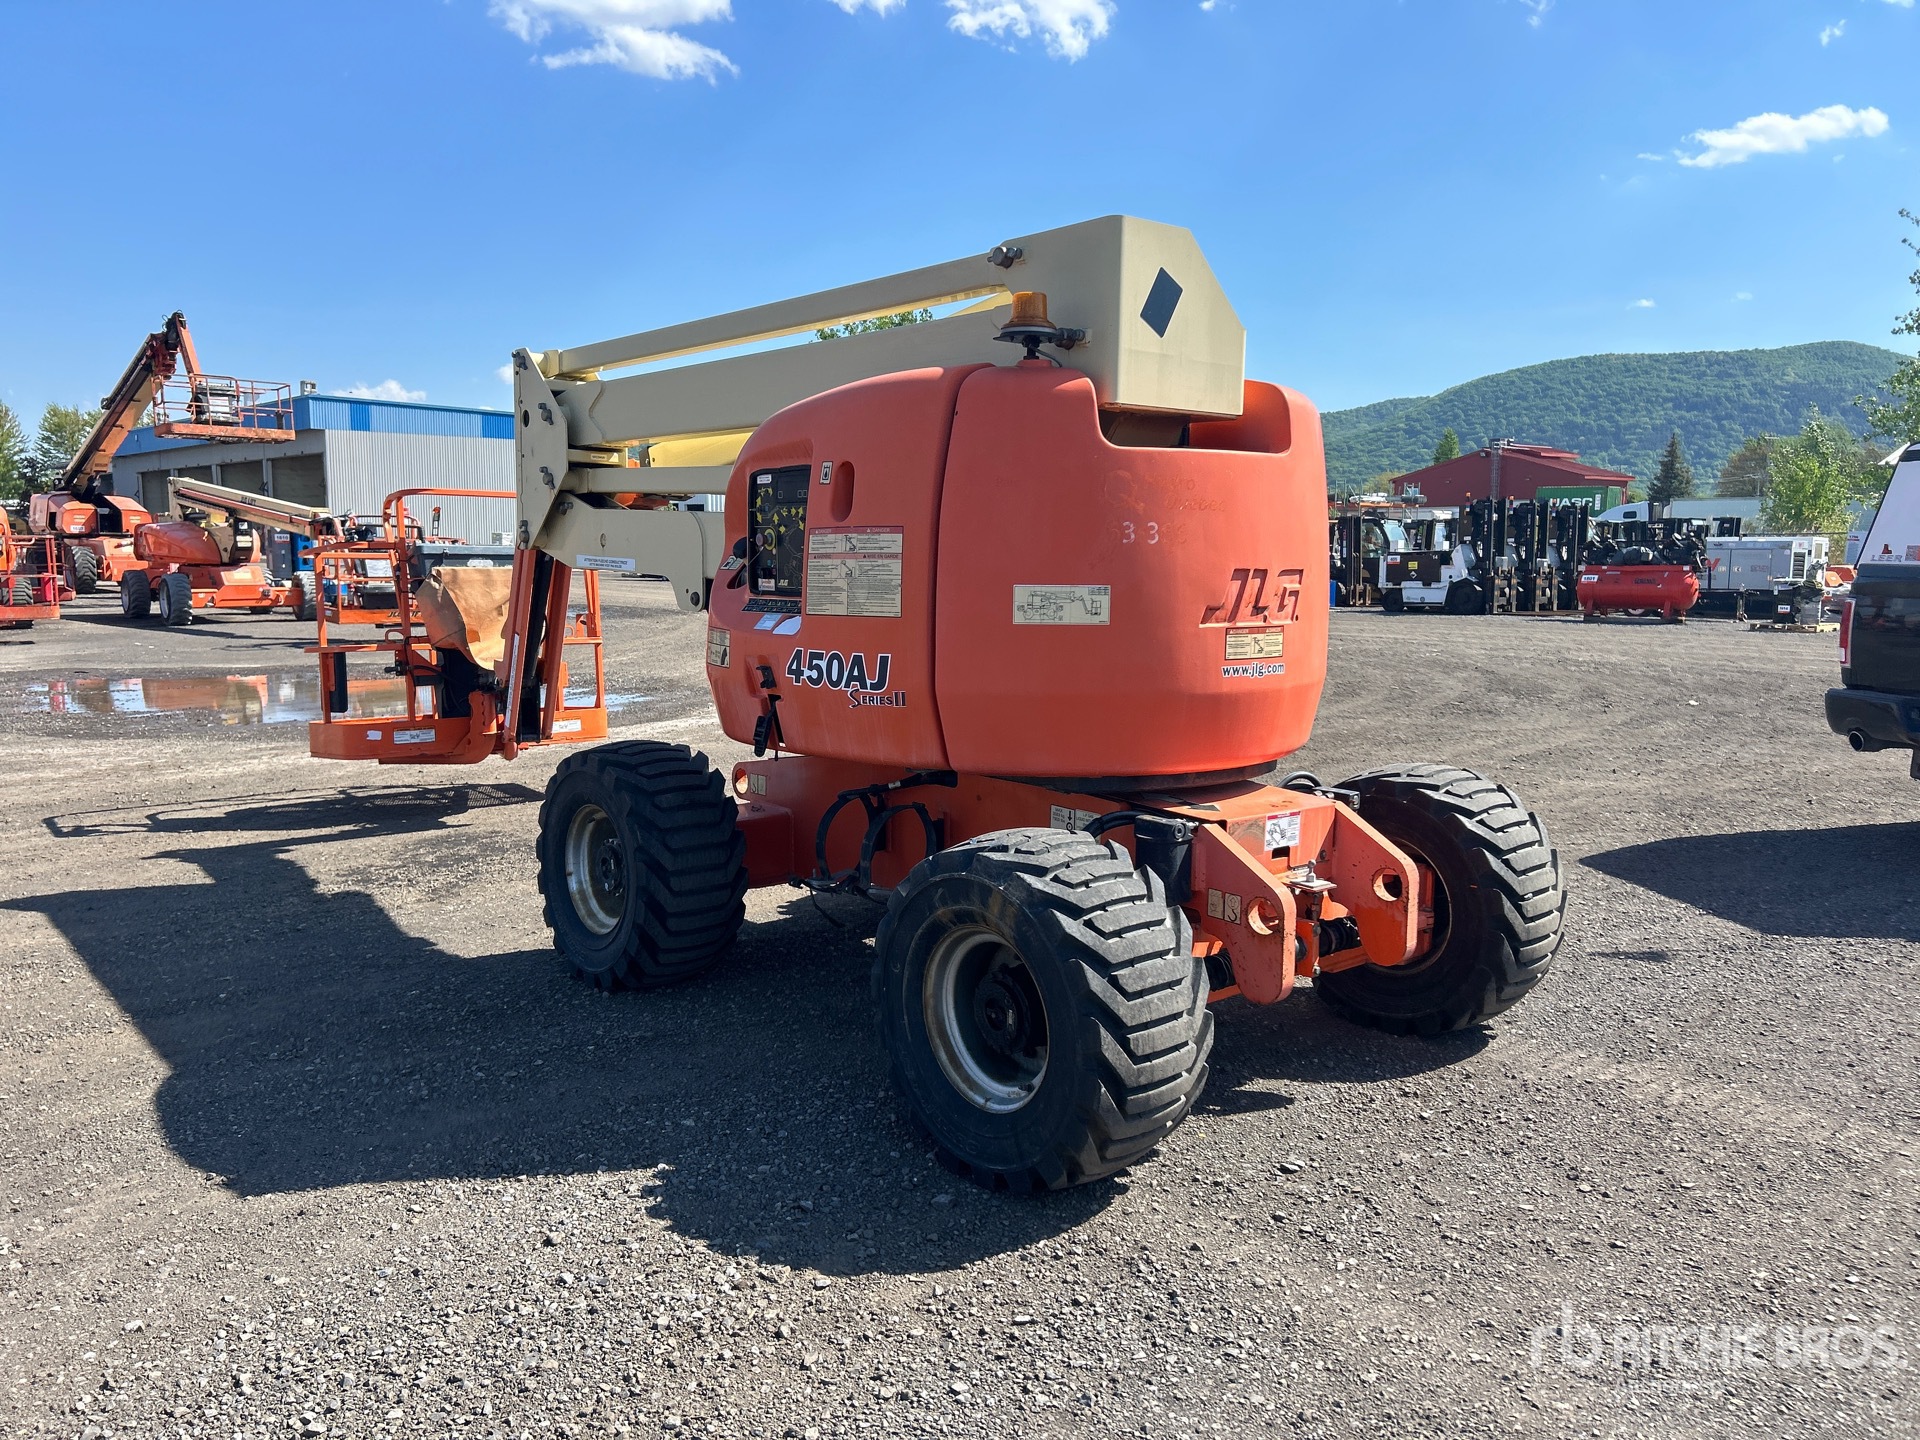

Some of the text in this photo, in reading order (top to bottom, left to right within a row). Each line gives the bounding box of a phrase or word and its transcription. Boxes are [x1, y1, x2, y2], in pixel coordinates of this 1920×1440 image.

[1870, 554, 1903, 562] LEER
[1199, 568, 1304, 628] JLG
[786, 647, 891, 692] 450AJ
[1221, 662, 1285, 678] www.jlg.com
